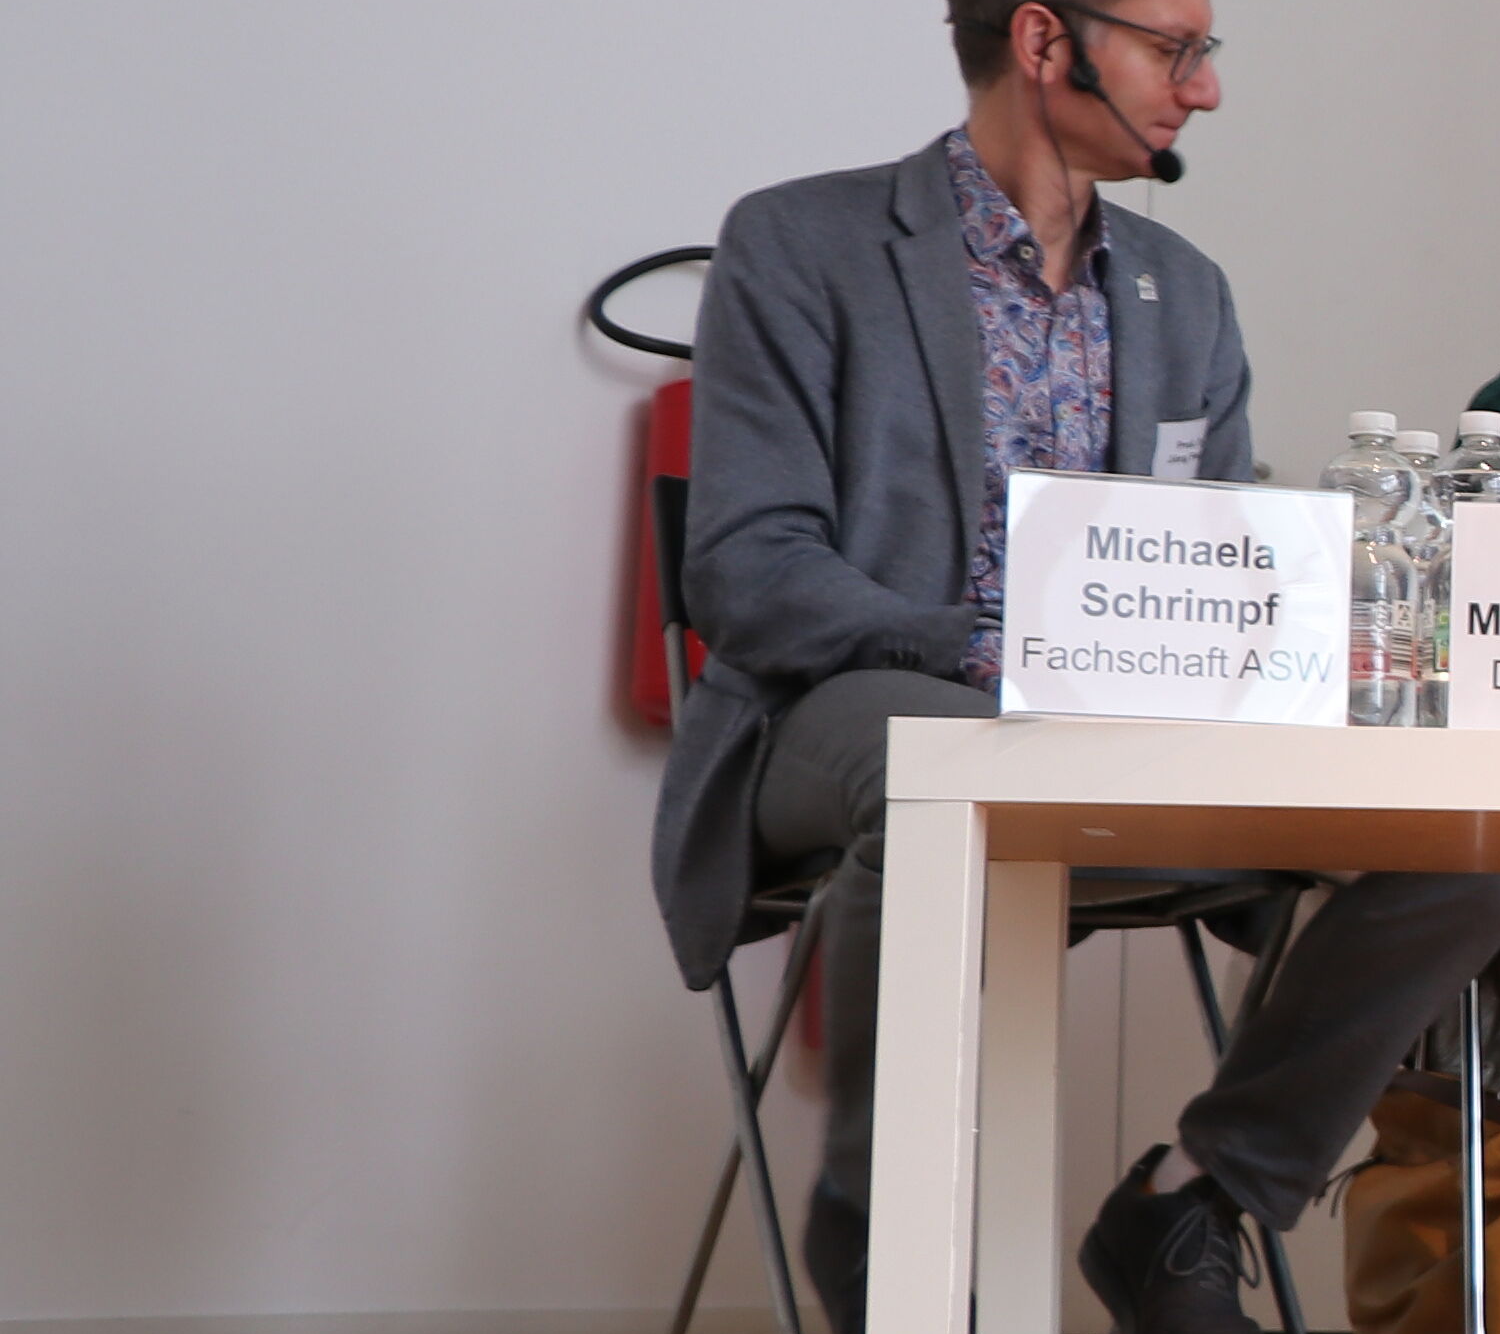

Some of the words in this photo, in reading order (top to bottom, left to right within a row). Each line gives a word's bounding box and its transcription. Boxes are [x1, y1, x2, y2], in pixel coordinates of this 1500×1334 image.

[1087, 526, 1274, 570] Michaela
[1082, 583, 1280, 633] Schrimpf
[1021, 636, 1229, 678] Fachschaft
[1237, 648, 1333, 683] ASW
